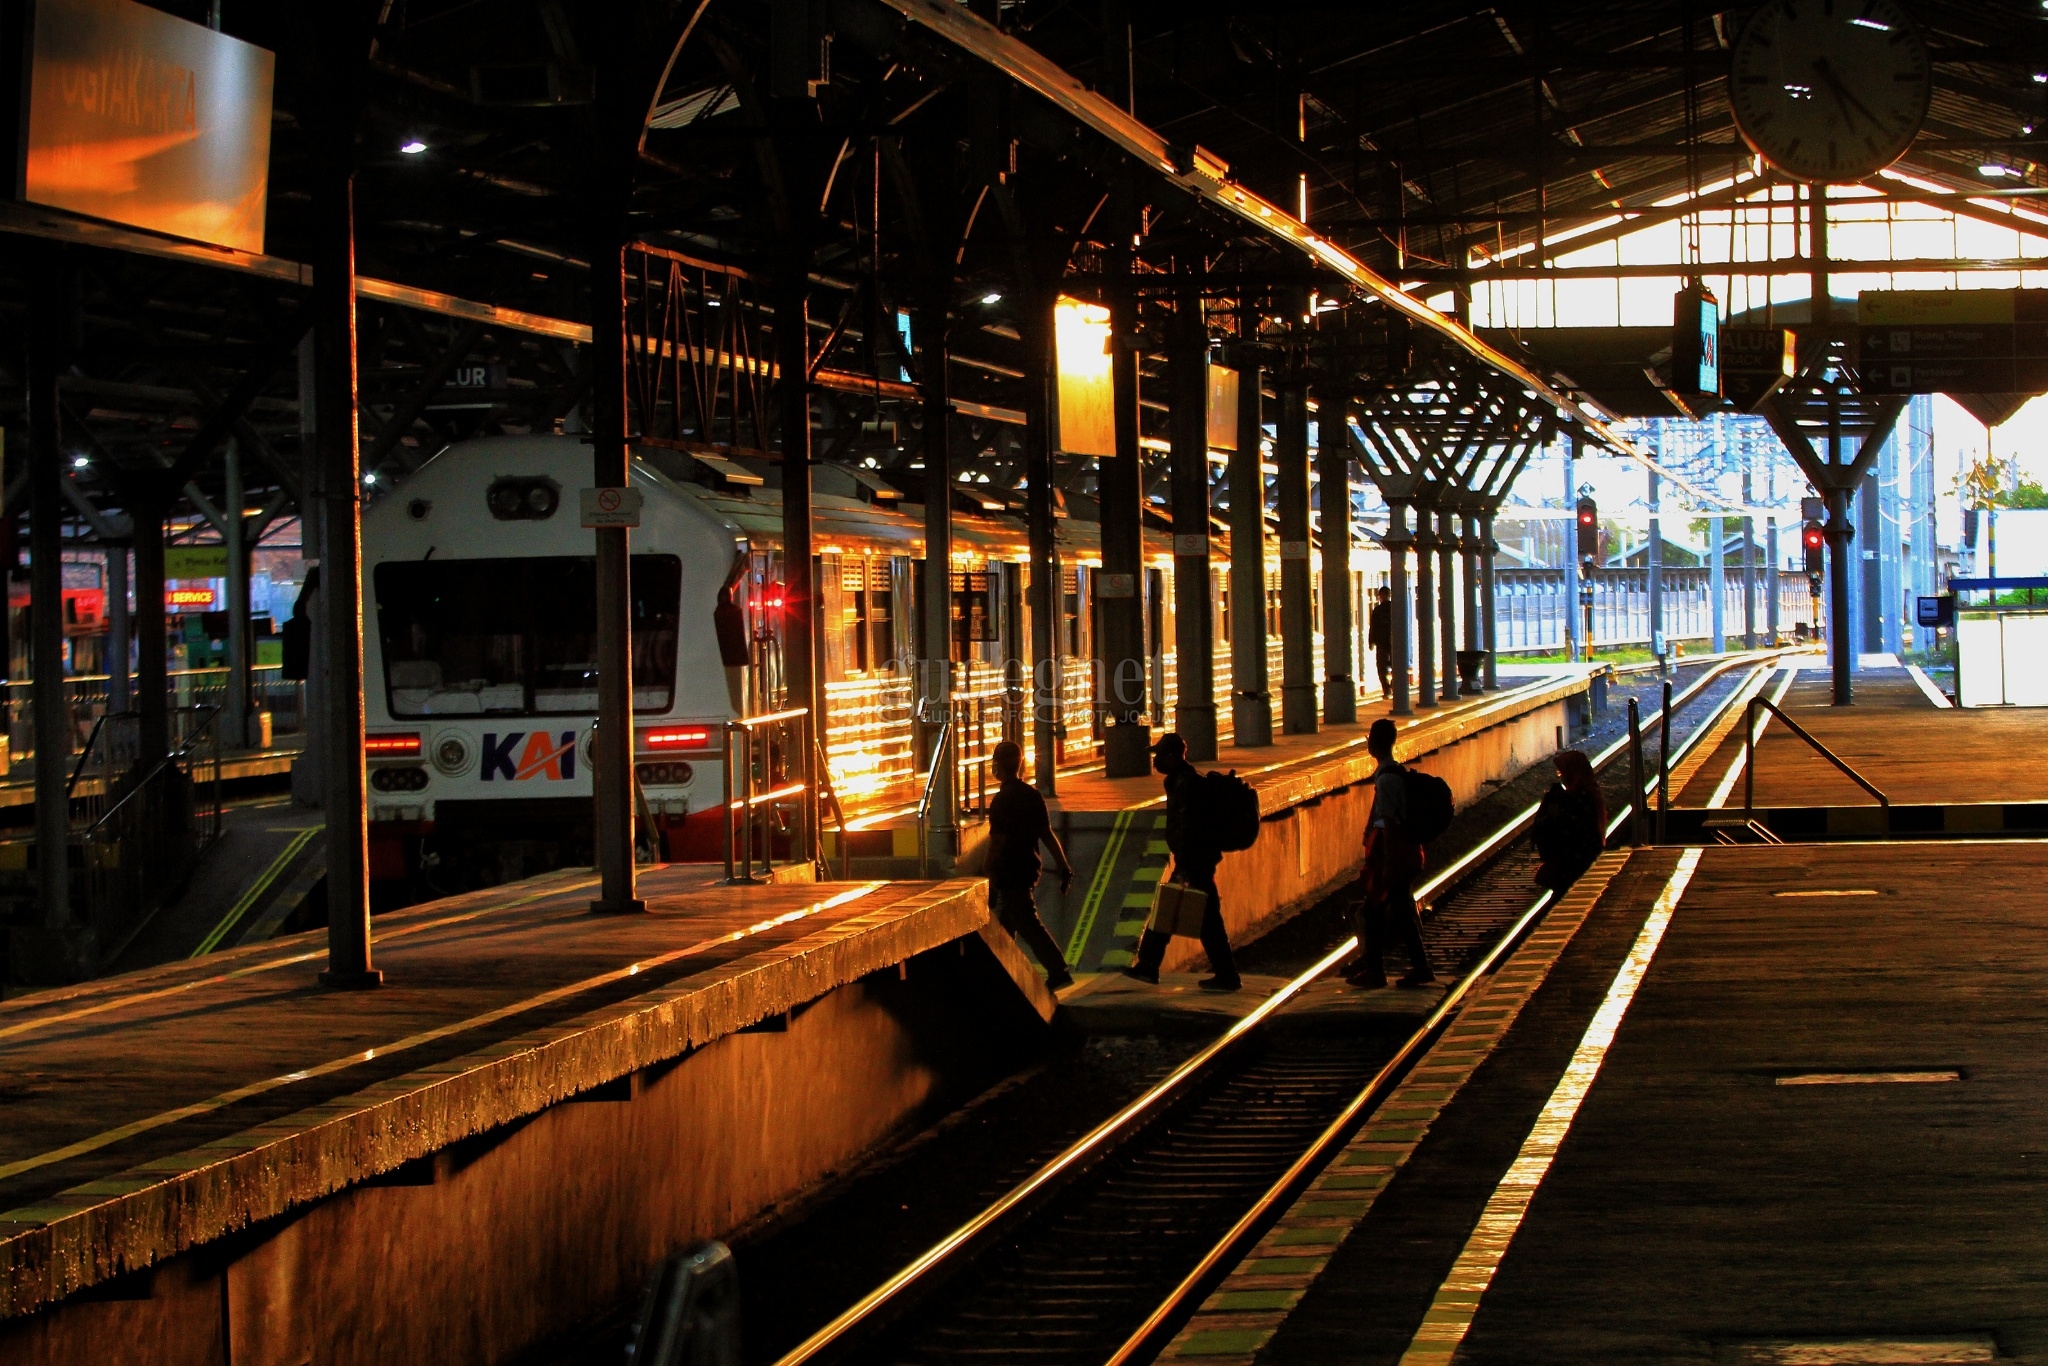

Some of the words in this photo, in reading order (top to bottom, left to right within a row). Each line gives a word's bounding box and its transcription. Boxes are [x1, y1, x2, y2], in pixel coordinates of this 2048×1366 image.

[48, 44, 198, 141] OGYAKARTA
[1721, 332, 1778, 350] ALUR
[1721, 354, 1762, 365] TRACK
[1734, 377, 1749, 393] 3
[1583, 483, 1591, 496] 3
[173, 592, 213, 603] SERVICE
[481, 731, 575, 781] KAI
